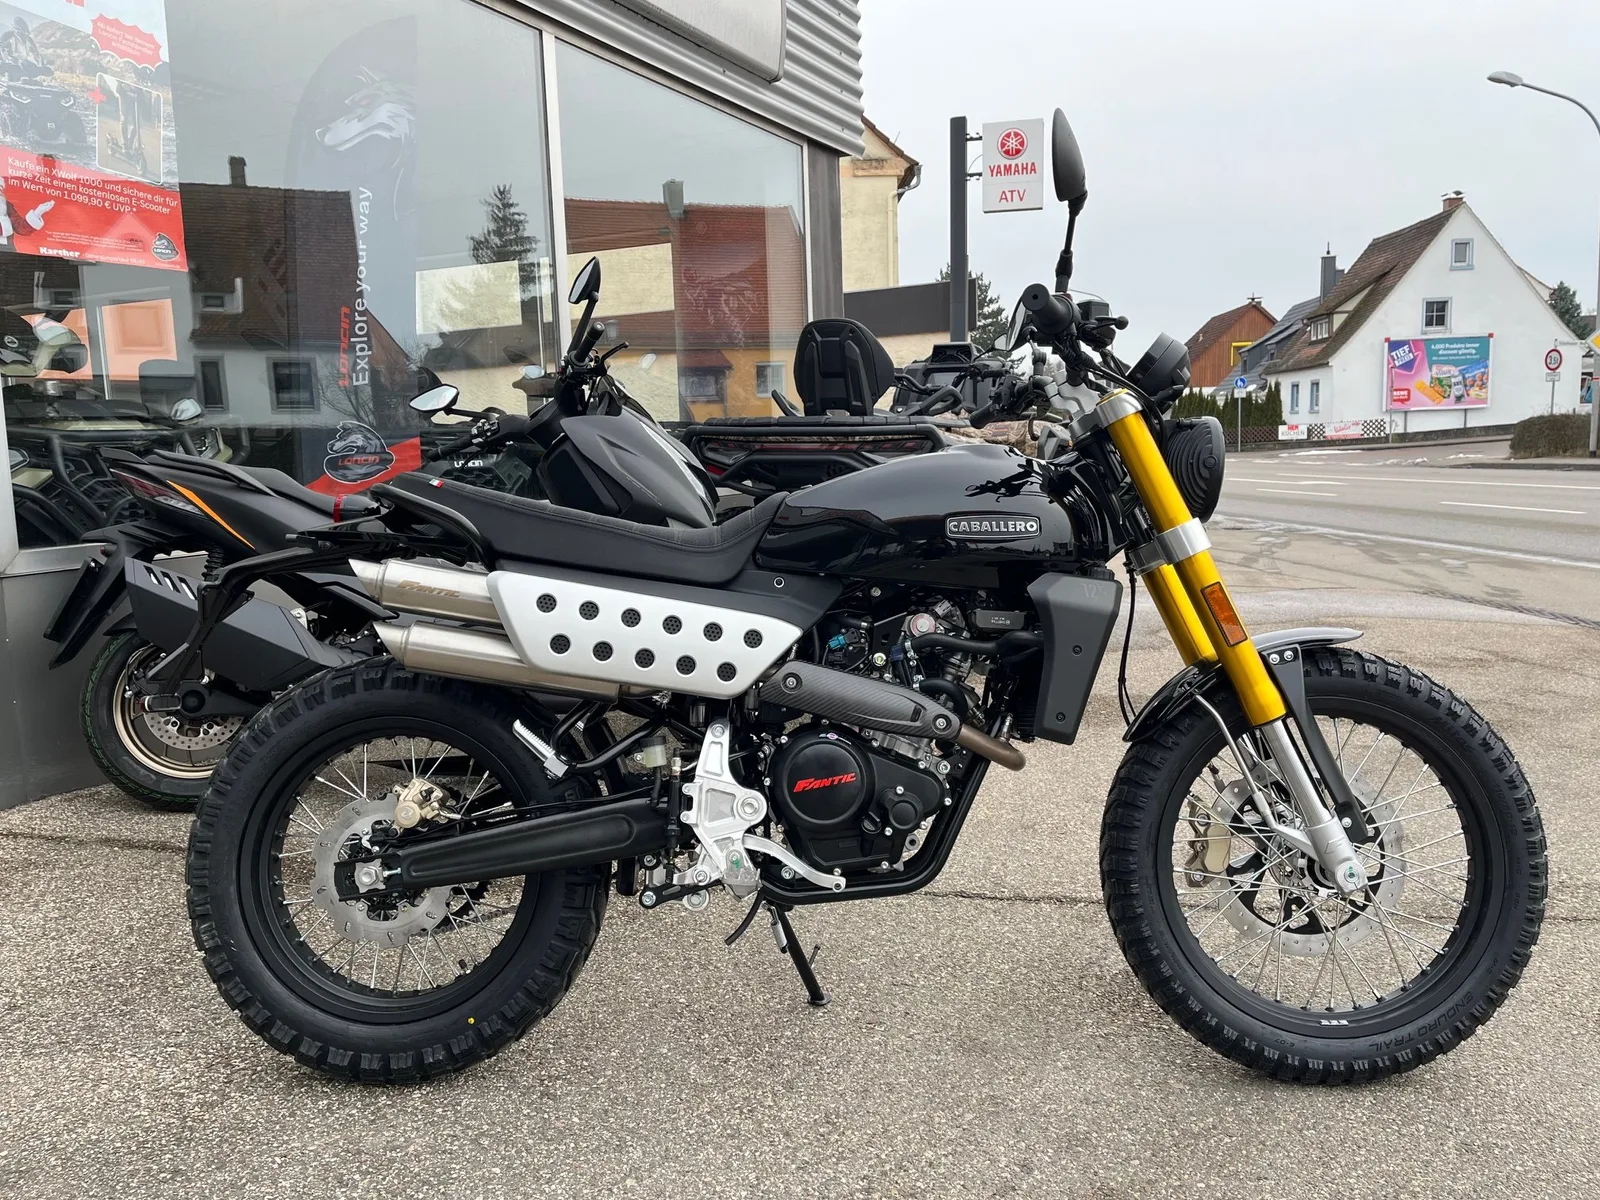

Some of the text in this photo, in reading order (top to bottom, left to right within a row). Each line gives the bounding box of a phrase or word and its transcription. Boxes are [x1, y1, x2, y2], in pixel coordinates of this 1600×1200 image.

[988, 162, 1036, 177] YAMAHA
[8, 156, 178, 207] Kaufe ein XWolf 1000 und sichere dir für
[8, 166, 170, 214] kurze Zeit einen kostenlosen E-Scooter
[8, 177, 20, 187] im
[22, 182, 44, 193] Wert
[44, 188, 62, 197] von
[64, 191, 103, 208] 1.099,90
[104, 200, 111, 209] €
[999, 189, 1026, 203] ATV
[40, 246, 80, 258] Karcher
[350, 186, 372, 386] Explore your way
[1391, 344, 1410, 360] TIEF
[950, 521, 1037, 532] CABALLERO
[397, 580, 460, 597] FANTIC
[793, 772, 856, 792] FANTIC
[1369, 991, 1474, 1052] ENDURO TRAIL
